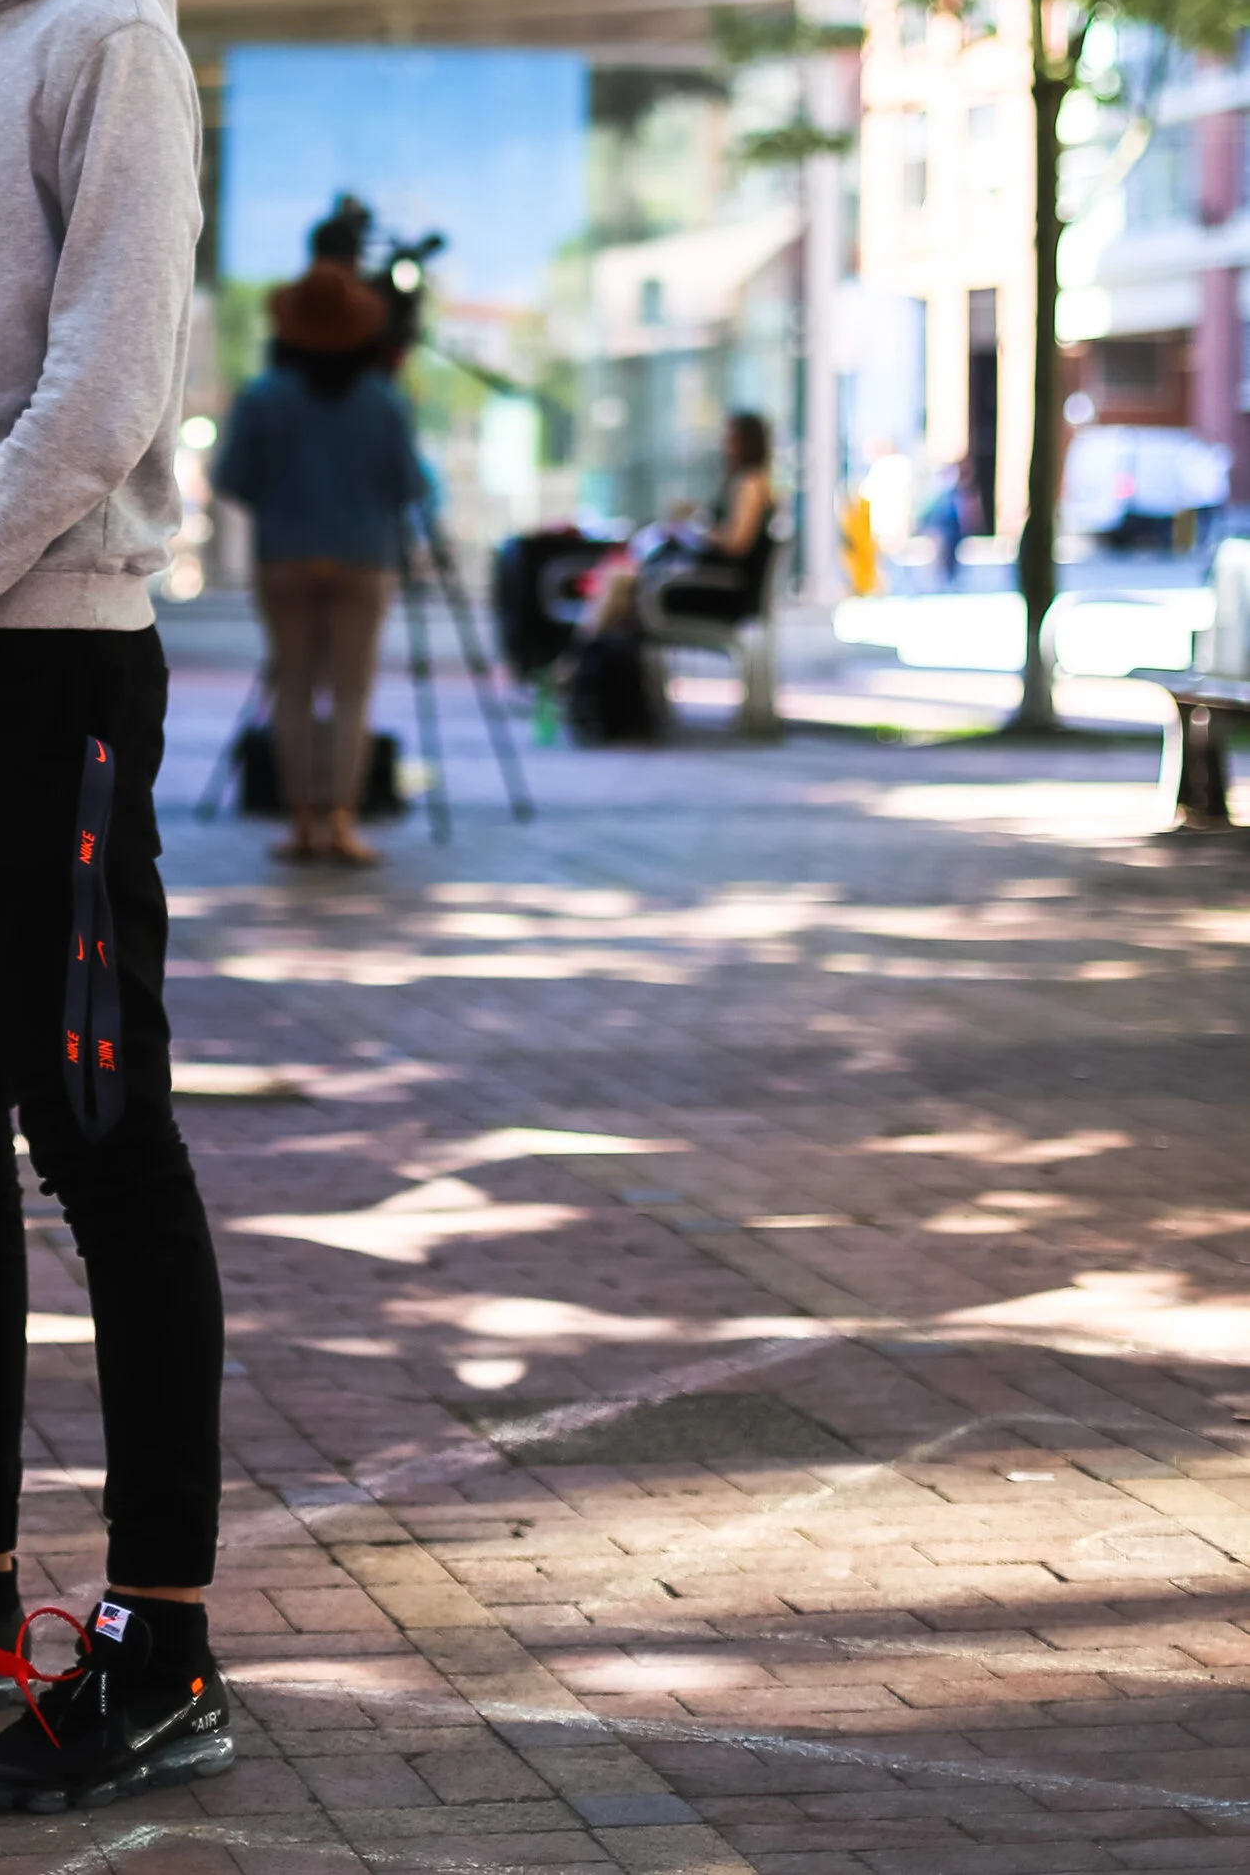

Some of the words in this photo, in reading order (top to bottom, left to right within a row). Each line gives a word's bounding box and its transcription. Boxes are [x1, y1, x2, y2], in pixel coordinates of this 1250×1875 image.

[79, 829, 96, 865] NIKE
[66, 1028, 80, 1064] NIKE
[97, 1039, 116, 1071] NIKE
